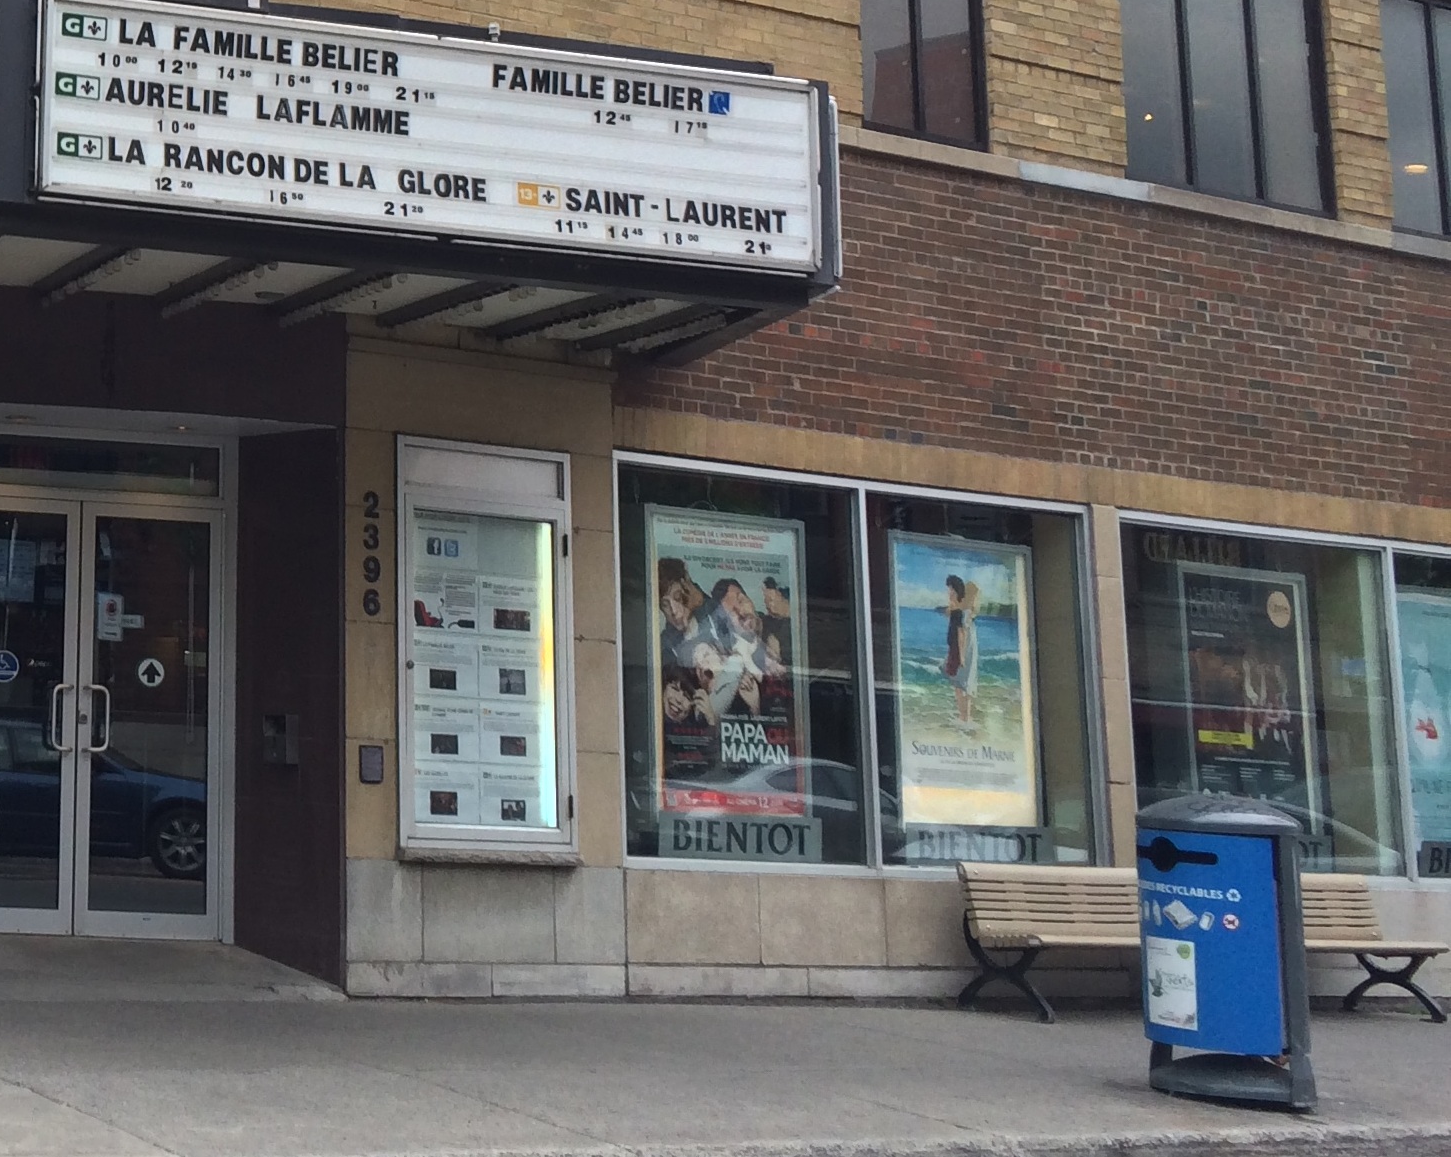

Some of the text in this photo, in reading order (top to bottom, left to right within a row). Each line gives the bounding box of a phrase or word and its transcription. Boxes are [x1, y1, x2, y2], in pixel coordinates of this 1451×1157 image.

[119, 18, 156, 47] LA
[173, 24, 293, 65] FAMILLE
[302, 41, 398, 77] BELIER
[105, 77, 229, 116] AURELIE
[256, 94, 410, 136] LAFLAMME
[492, 63, 704, 112] FAMILLE BELIER
[108, 136, 146, 166] LA
[164, 142, 285, 181] RANCON
[293, 157, 329, 185] DE
[339, 162, 377, 190] LA
[398, 168, 487, 202] GLORE
[565, 187, 645, 218] SAINT
[666, 197, 787, 234] LAURENT
[363, 490, 381, 617] 2396
[721, 721, 768, 743] PAPA
[722, 743, 789, 765] MAMAN
[673, 818, 811, 856] BIENTOT
[918, 829, 1042, 863] BIENTOT
[1156, 882, 1223, 900] RECYCLABLES
